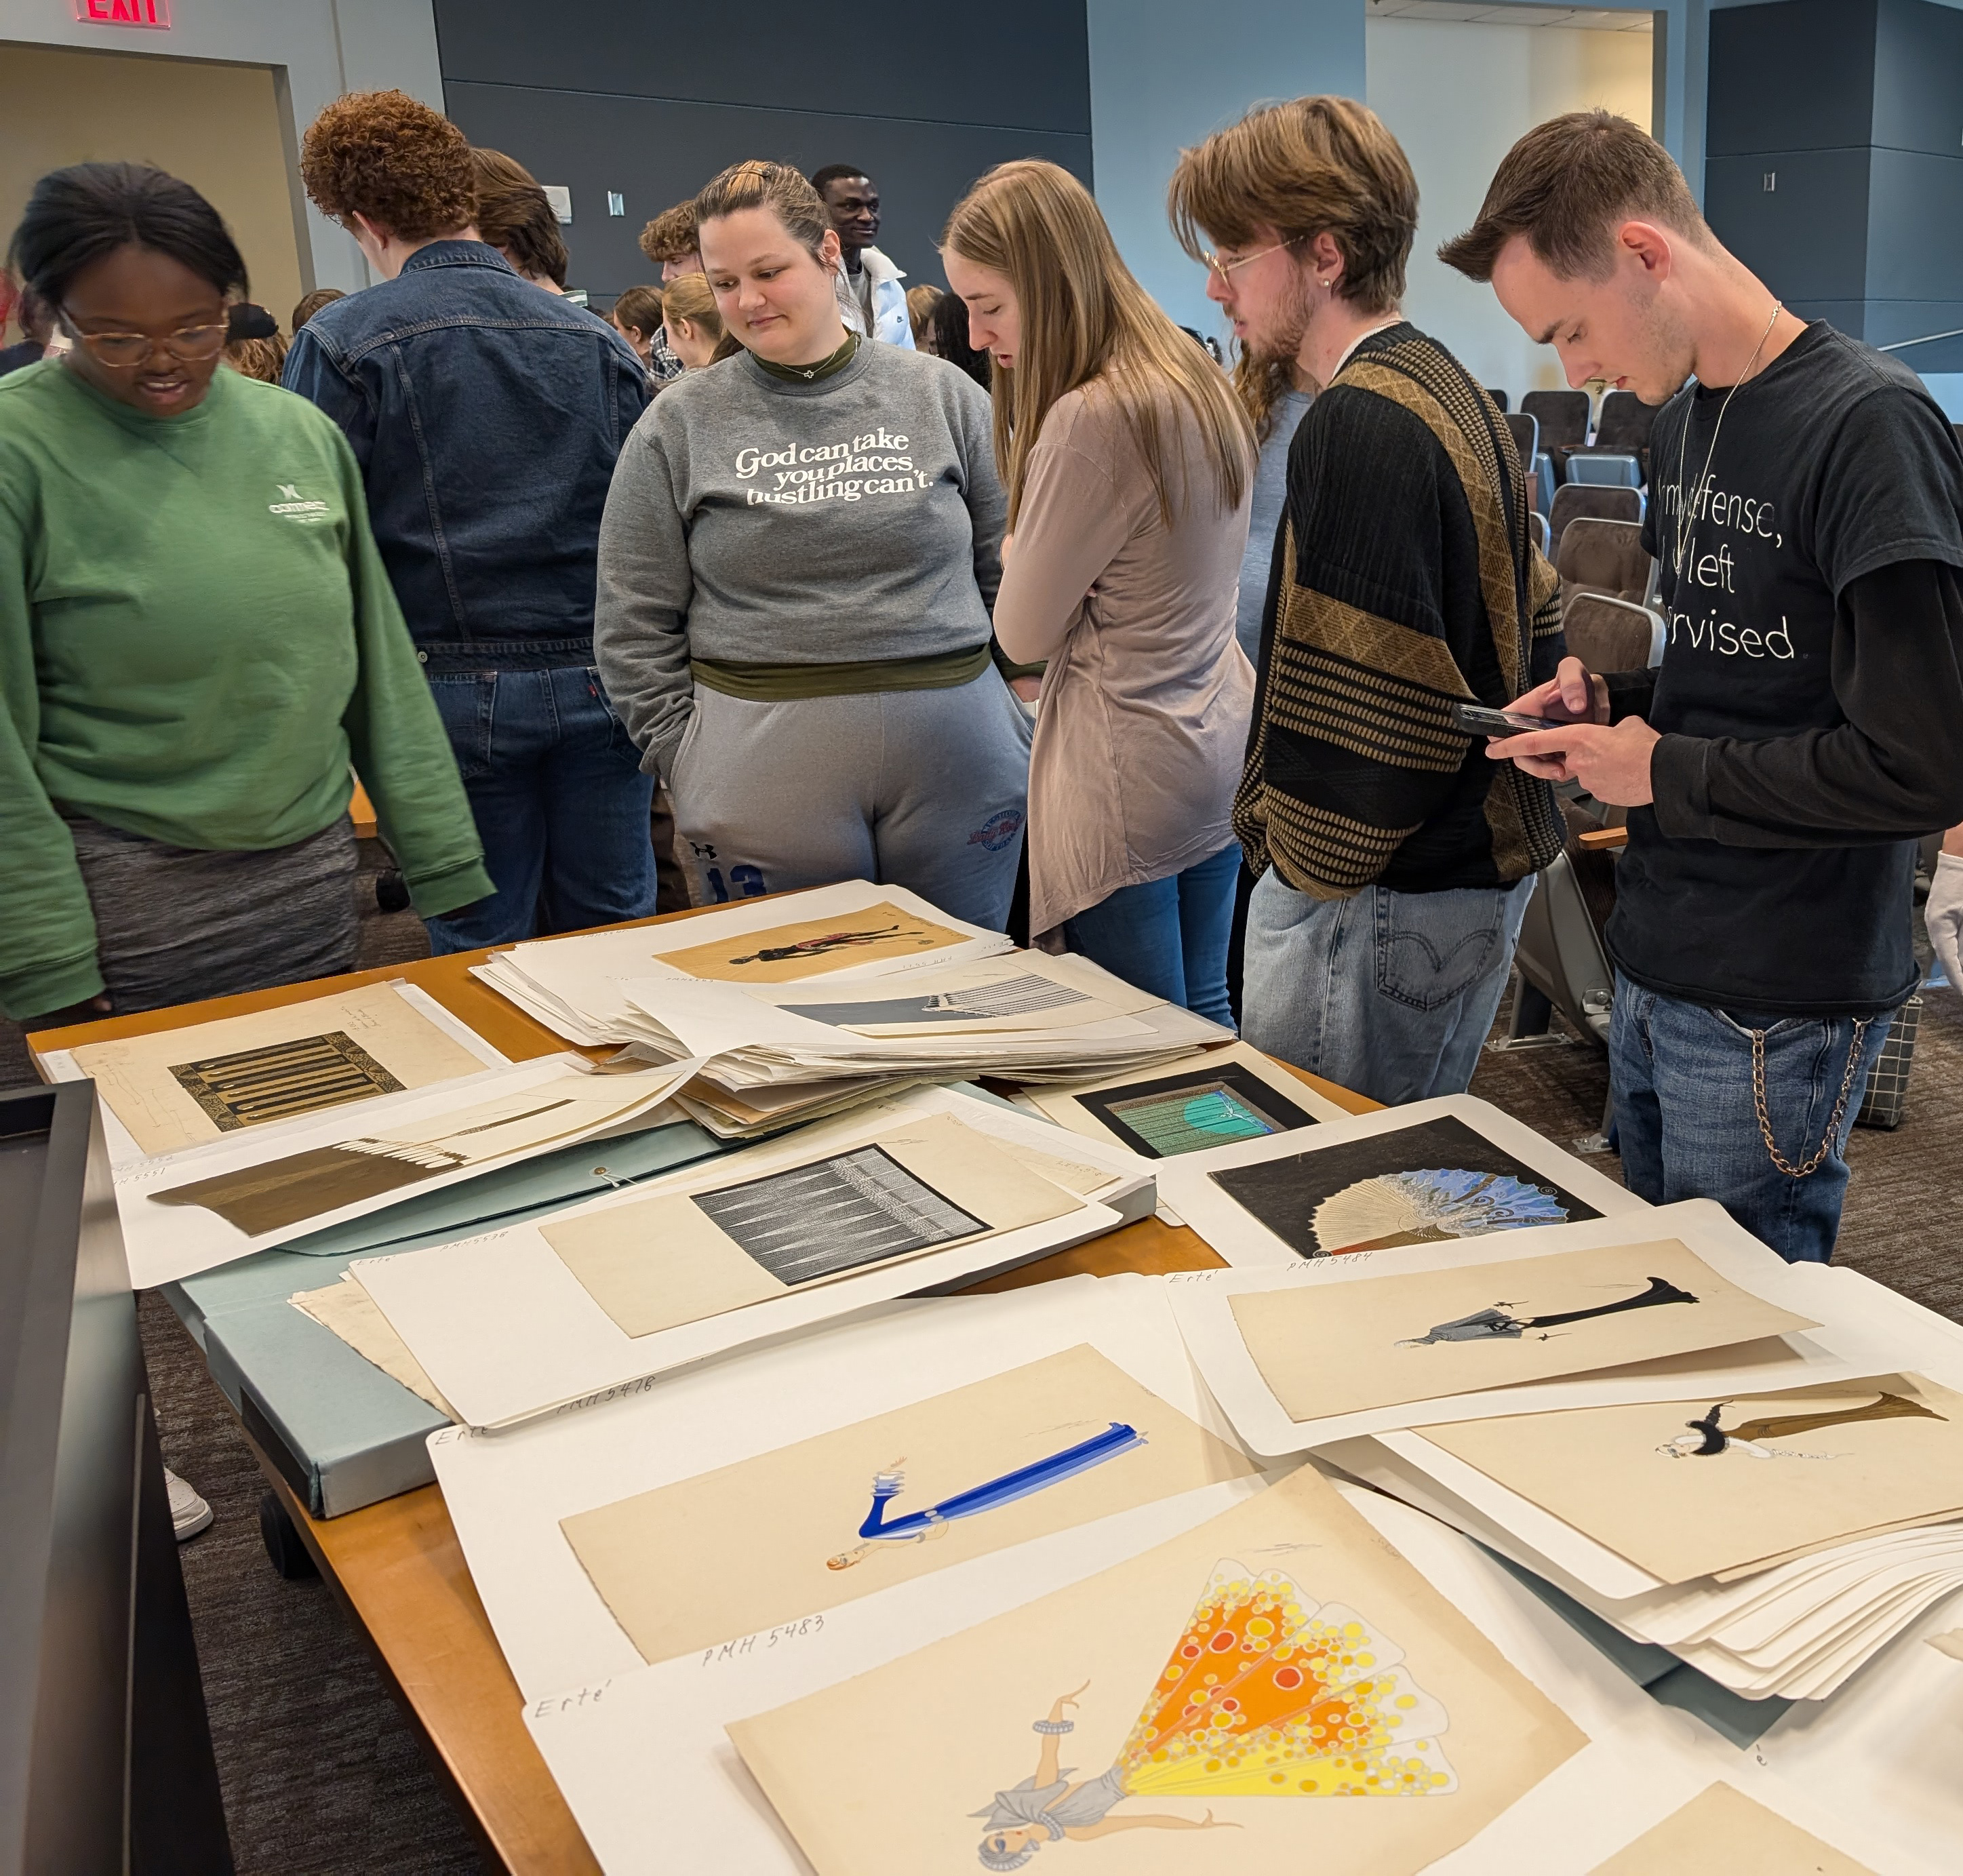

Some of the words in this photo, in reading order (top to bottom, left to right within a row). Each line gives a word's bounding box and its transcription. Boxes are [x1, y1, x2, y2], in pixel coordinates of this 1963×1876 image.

[735, 442, 797, 479] God
[799, 442, 850, 463] can
[852, 427, 909, 453] take
[774, 468, 825, 491] you
[826, 454, 914, 481] places
[747, 477, 864, 506] hustling
[863, 469, 934, 494] can't.
[1687, 537, 1735, 593] left
[1667, 605, 1795, 659] rvised
[134, 1167, 165, 1182] 5551
[1169, 1269, 1218, 1283] Erté
[535, 1679, 612, 1718] Erté
[702, 1635, 756, 1667] PMH
[767, 1615, 825, 1648] 5483
